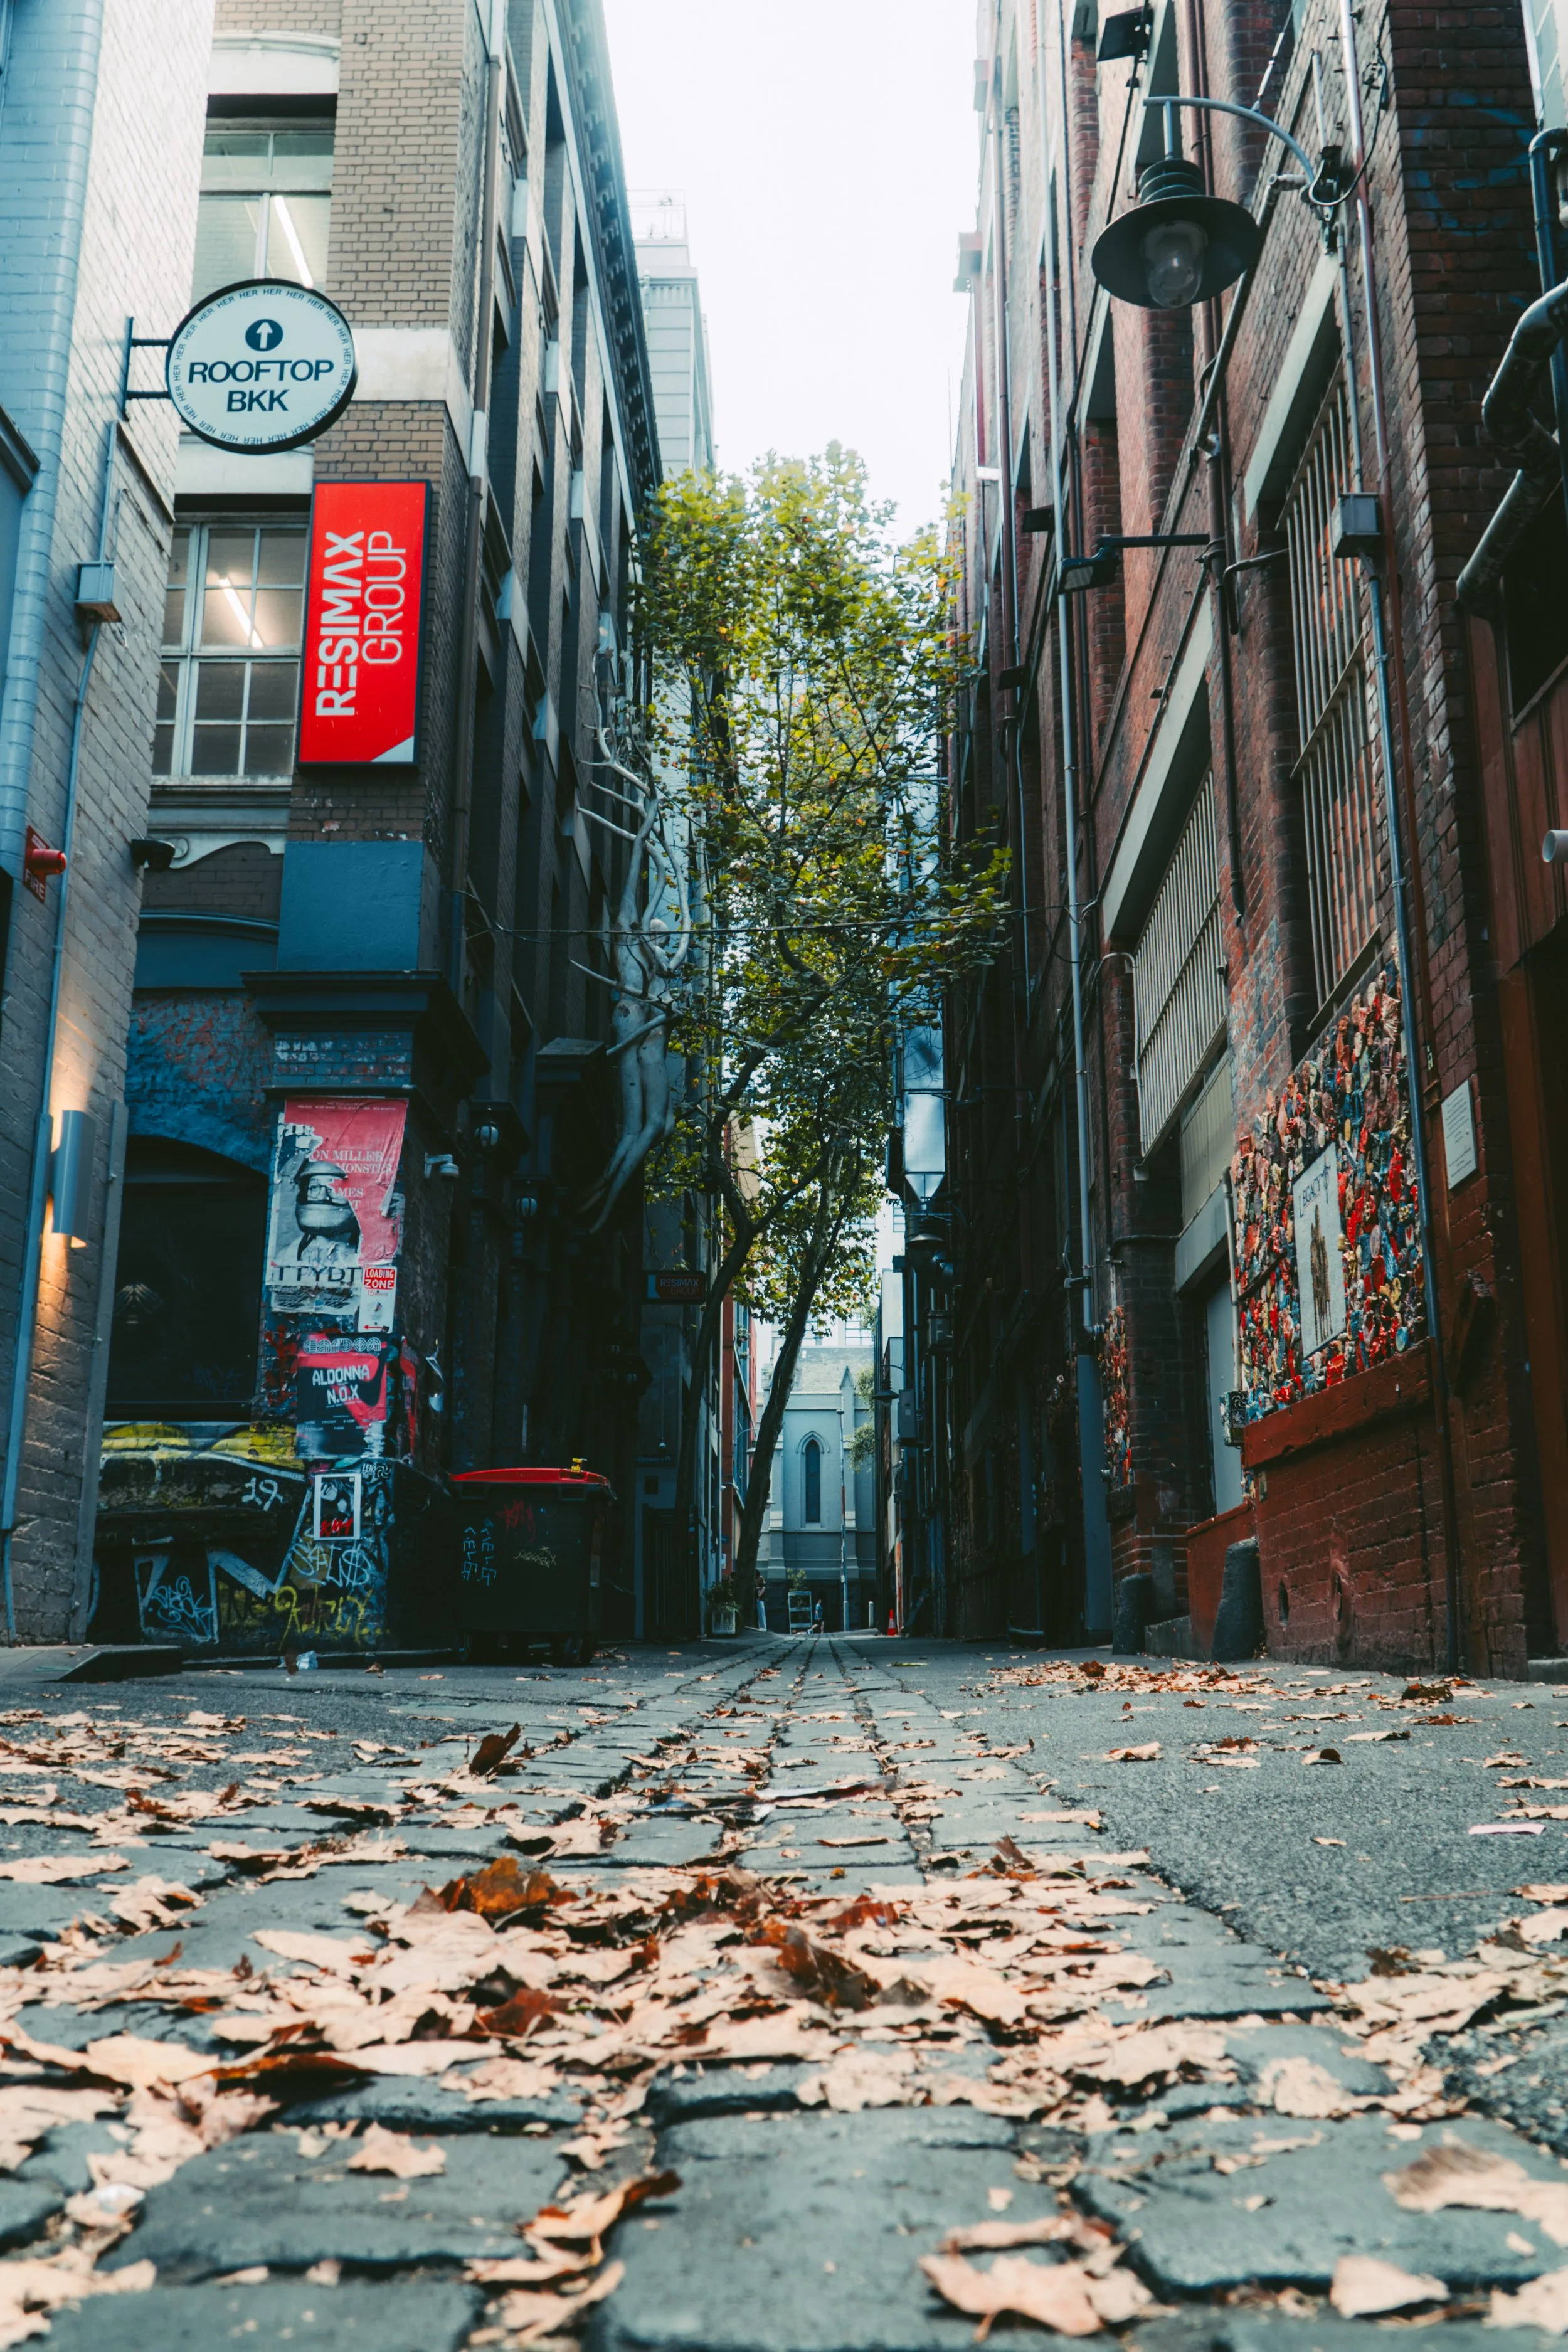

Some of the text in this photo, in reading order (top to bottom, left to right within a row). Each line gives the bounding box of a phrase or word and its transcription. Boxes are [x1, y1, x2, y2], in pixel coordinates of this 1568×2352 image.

[216, 296, 235, 309] HER
[238, 290, 258, 299] HER
[286, 290, 305, 301] HER
[307, 298, 325, 311] HER
[197, 308, 215, 322] HER
[324, 310, 340, 326] HER
[183, 324, 198, 341] HER
[336, 327, 349, 345] HER
[174, 344, 186, 361] HER
[343, 348, 351, 364] HER
[188, 359, 334, 383] ROOFTOP
[339, 369, 351, 386] HER
[174, 384, 186, 402] HER
[227, 389, 290, 412] BKK
[183, 403, 198, 420] HER
[199, 420, 217, 435] HER
[220, 432, 240, 443] HER
[361, 531, 406, 664] GROUP
[315, 531, 364, 716] RESIMAX
[25, 867, 45, 901] FIRE
[366, 1268, 394, 1279] LOADING
[364, 1279, 394, 1290] ZONE
[312, 1364, 370, 1386] ALDONNA
[327, 1384, 359, 1405] N.O.X
